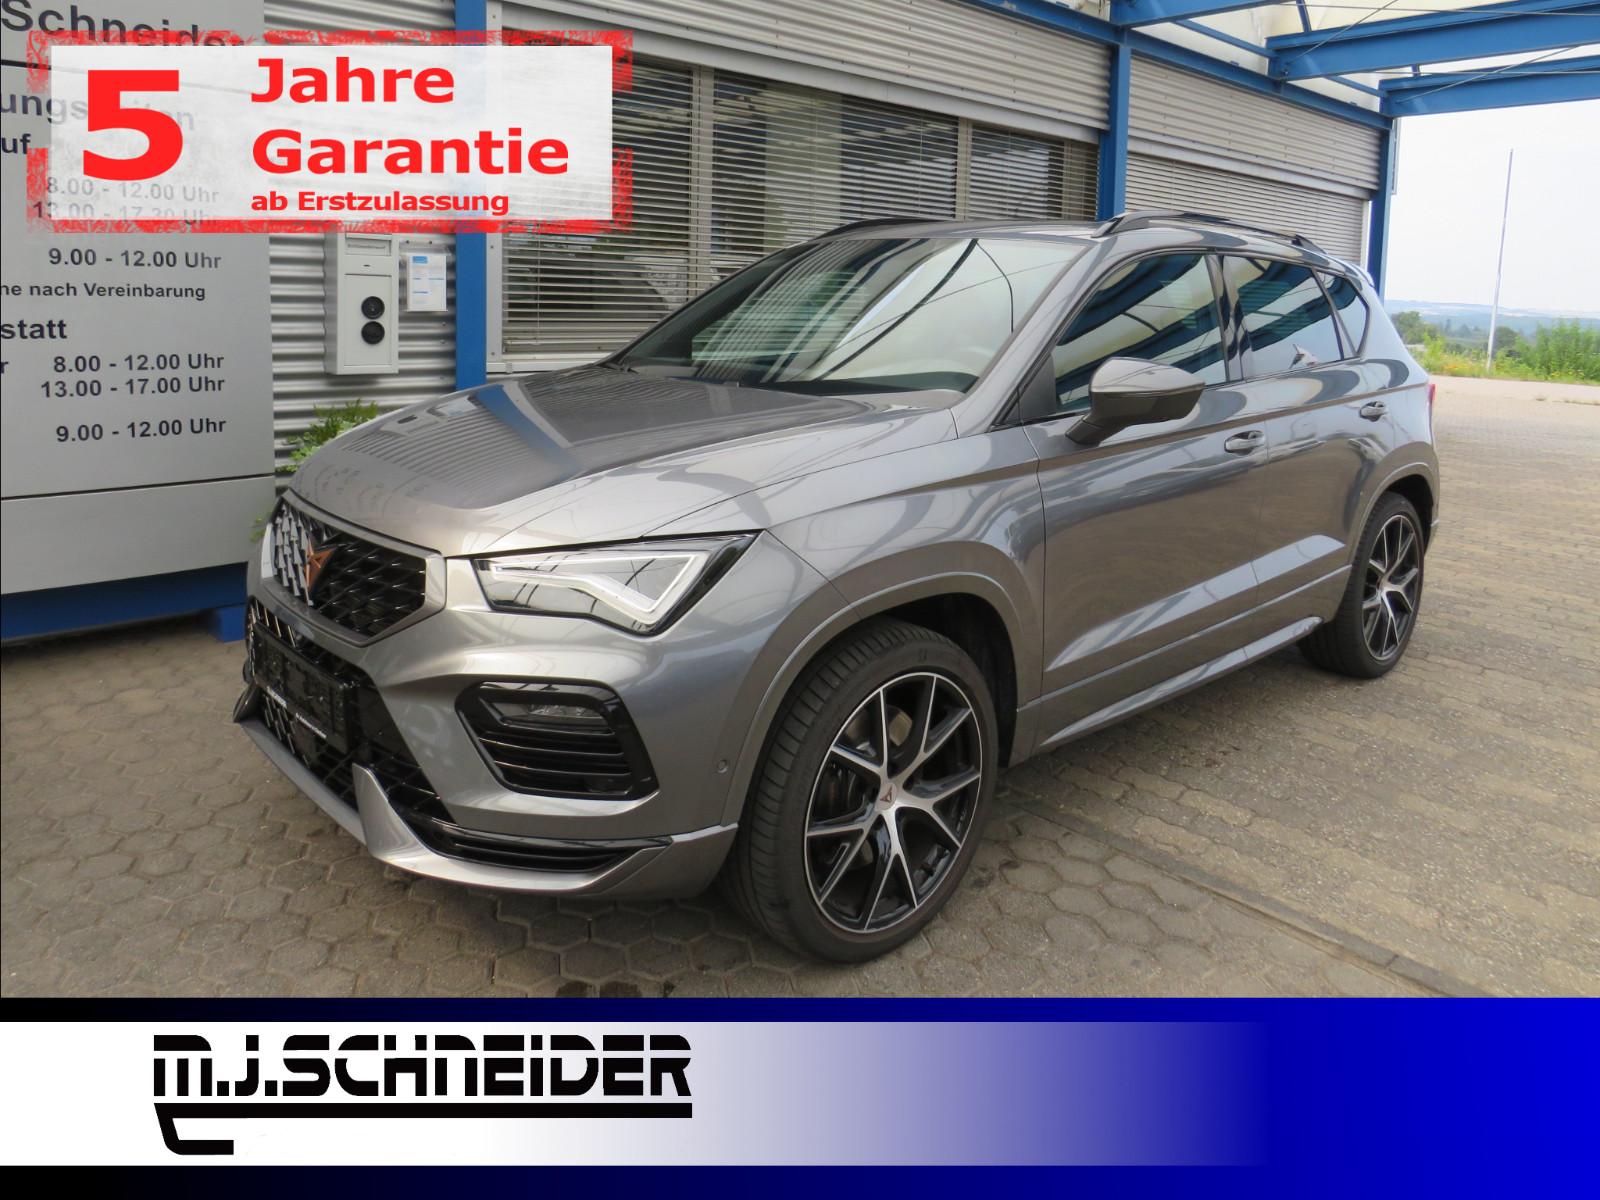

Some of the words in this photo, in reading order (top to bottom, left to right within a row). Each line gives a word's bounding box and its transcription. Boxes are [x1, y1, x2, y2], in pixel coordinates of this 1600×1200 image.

[1, 0, 245, 46] Schneid
[119, 181, 174, 201] 12.00
[183, 186, 219, 202] Uhr
[33, 201, 95, 221] 1300
[48, 247, 97, 266] 9.00
[120, 250, 177, 268] 12.00
[184, 252, 222, 269] Uhr
[29, 282, 77, 297] nach
[83, 282, 206, 301] Vereinbarung
[1, 319, 68, 340] statt
[53, 355, 101, 373] 8.00
[124, 354, 181, 371] 12.00
[187, 353, 225, 370] Uhr
[40, 379, 102, 398] 13.00
[125, 376, 182, 395] 17.00
[188, 376, 225, 393] Uhr
[55, 423, 104, 443] 9.00
[127, 419, 183, 438] 12.00
[190, 418, 227, 435] Uhr
